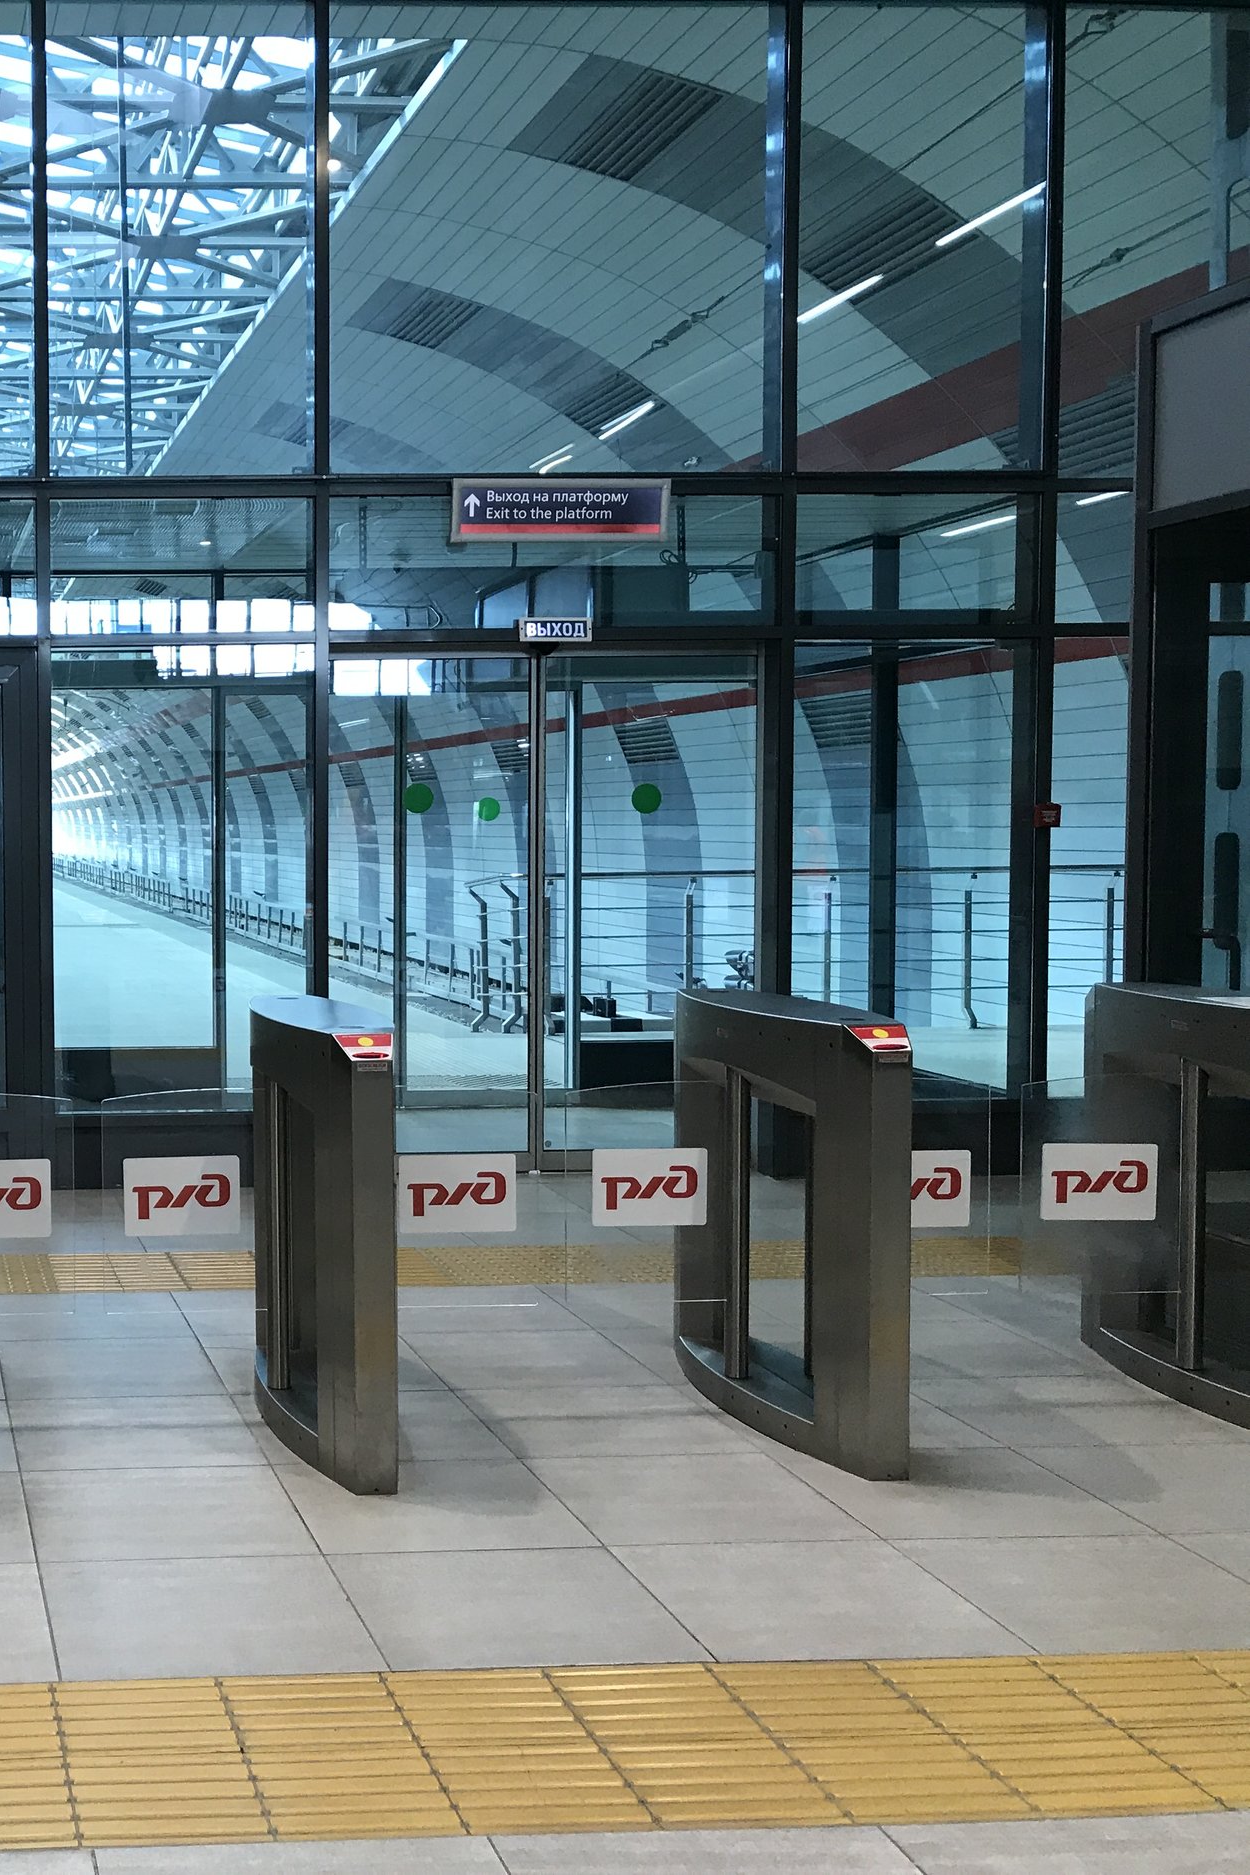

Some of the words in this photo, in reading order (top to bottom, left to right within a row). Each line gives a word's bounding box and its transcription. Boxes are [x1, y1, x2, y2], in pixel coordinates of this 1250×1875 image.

[486, 490, 530, 504] Выход
[533, 493, 549, 502] на
[552, 490, 629, 505] платформу
[486, 507, 510, 520] Exit
[513, 508, 527, 520] to
[530, 506, 552, 520] the
[555, 506, 612, 522] platform
[526, 622, 585, 638] ВЫХОД
